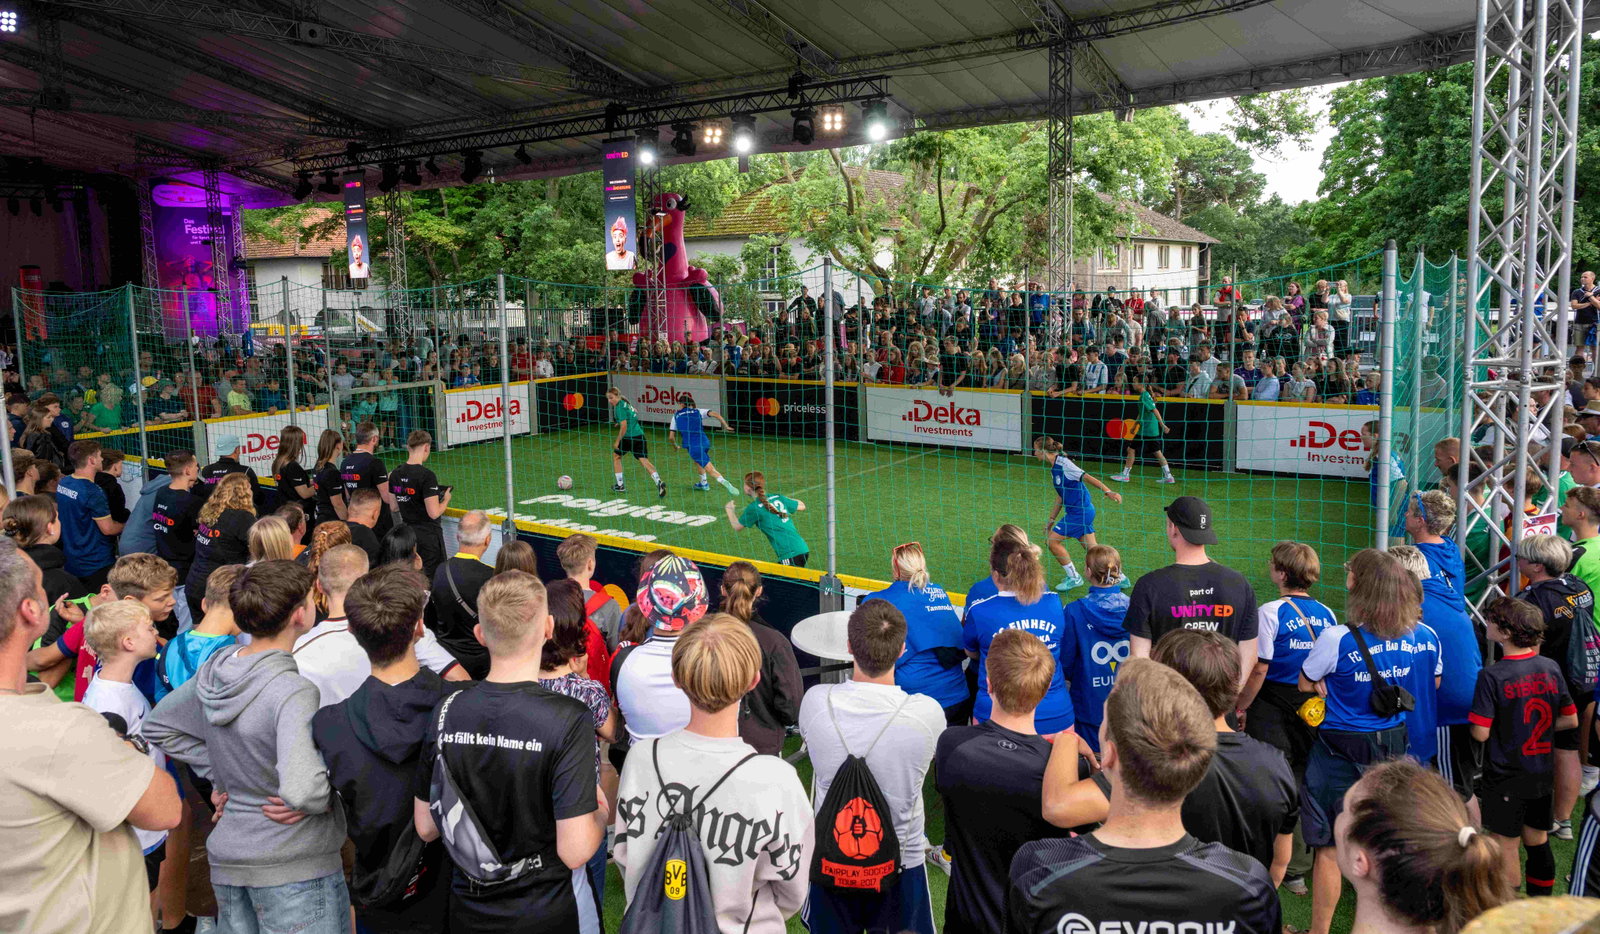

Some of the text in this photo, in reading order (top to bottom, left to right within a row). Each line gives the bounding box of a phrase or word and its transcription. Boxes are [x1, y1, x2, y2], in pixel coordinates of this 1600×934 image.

[783, 402, 827, 414] priceless
[914, 400, 981, 426] Deka
[467, 419, 516, 432] Investmes
[914, 424, 973, 437] Investments
[248, 453, 276, 463] Invest
[1308, 451, 1365, 465] Investm
[1190, 587, 1214, 597] part of
[1009, 619, 1056, 634] EINHEIT
[1184, 621, 1219, 631] CREW
[1286, 620, 1297, 632] FC
[1348, 650, 1362, 664] FC
[1092, 676, 1115, 688] EUL
[1521, 698, 1552, 756] 2
[454, 731, 475, 744] fällt
[476, 733, 496, 746] kein
[497, 734, 524, 750] Name
[525, 738, 543, 752] ein
[665, 864, 687, 887] BVB
[824, 863, 894, 878] FAIRPLAY SOCCER
[838, 878, 877, 886] TOUR 2017
[670, 887, 680, 895] 09
